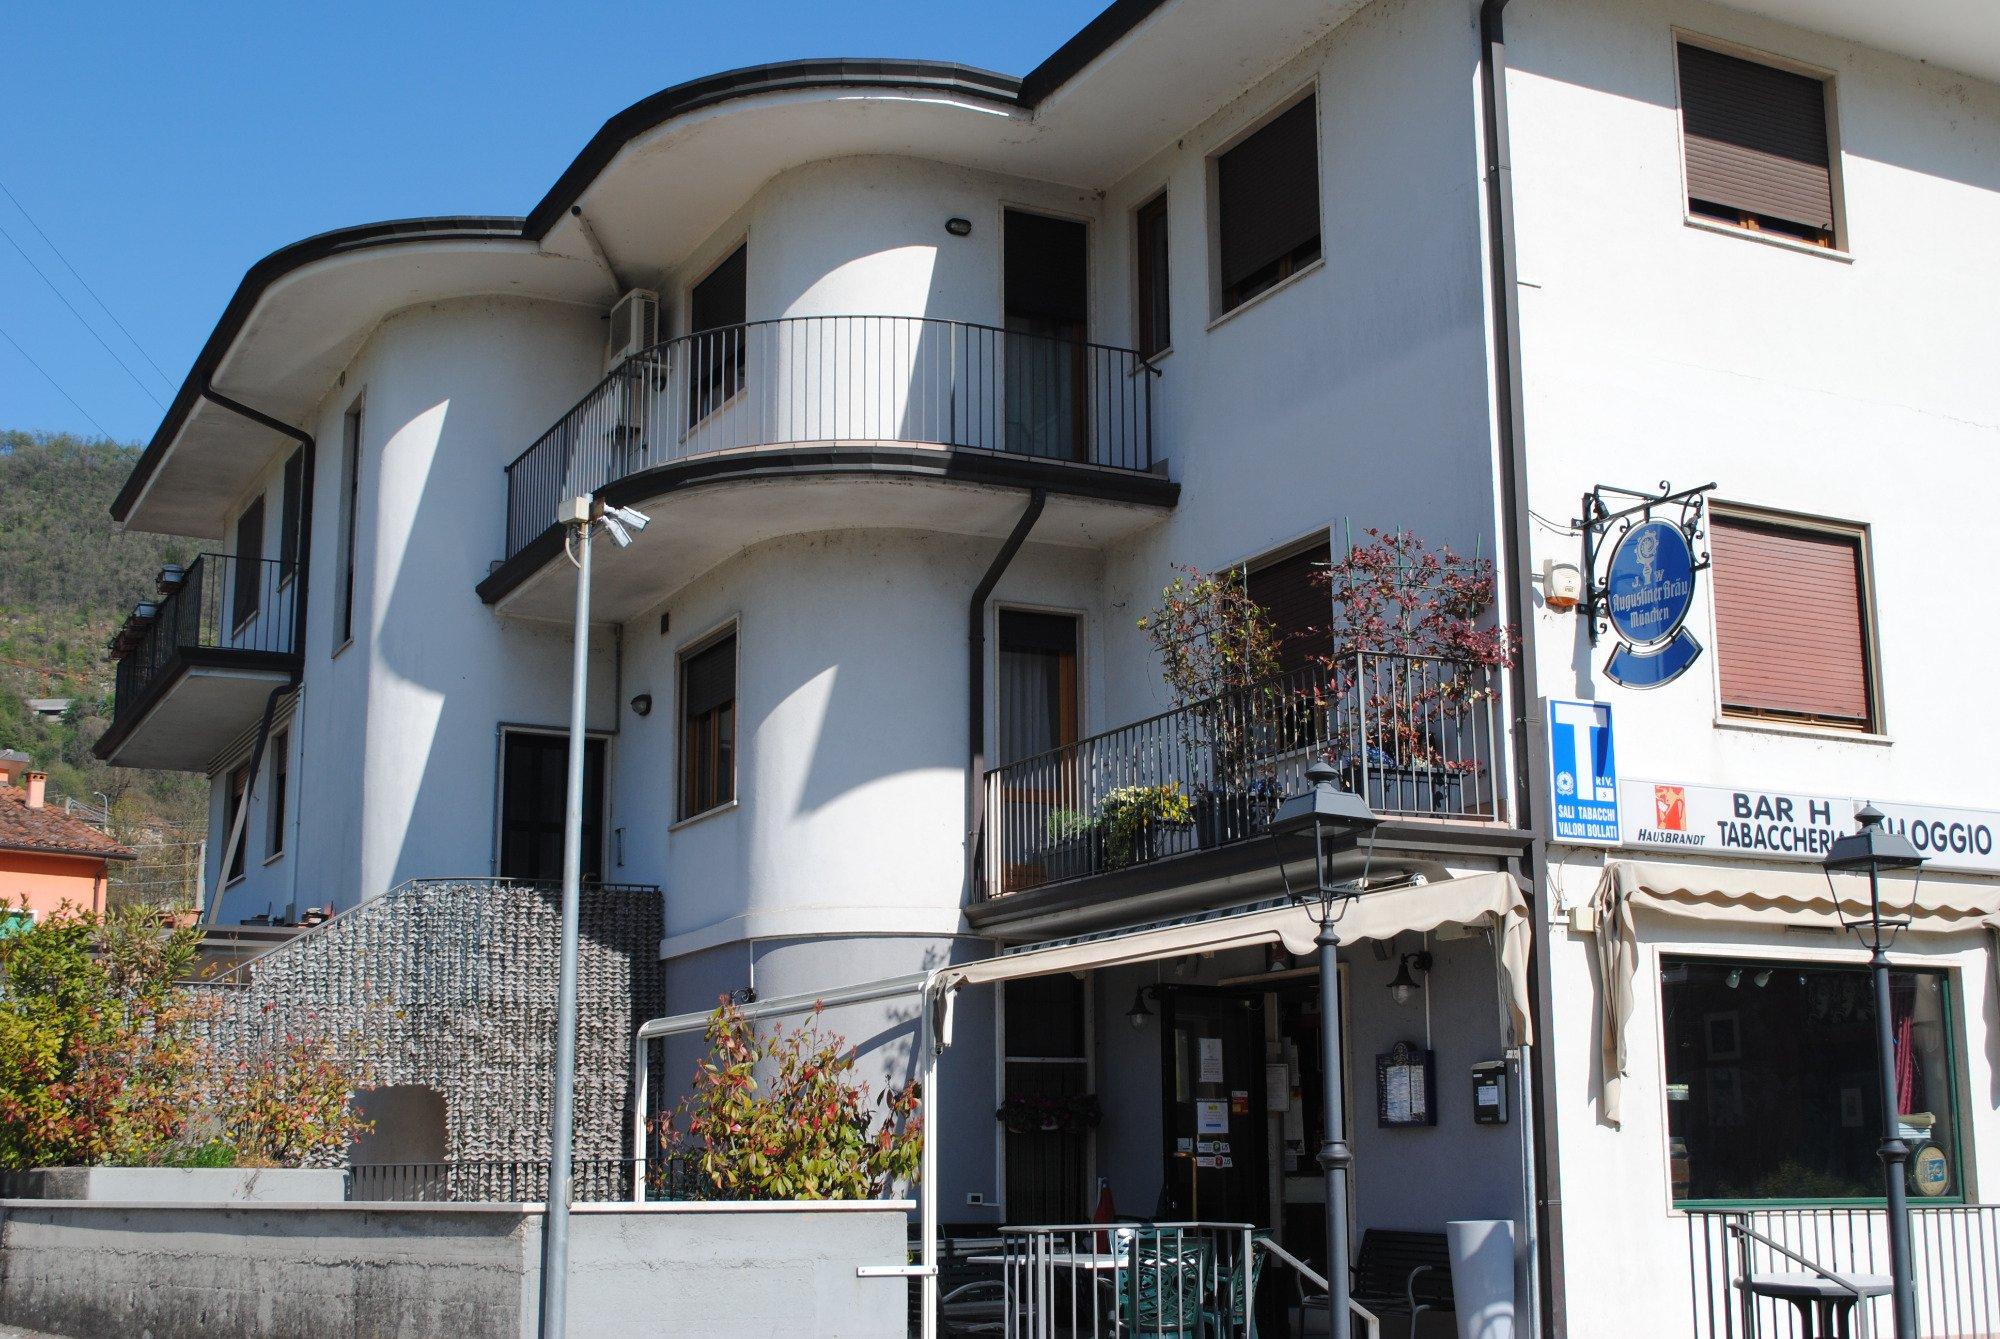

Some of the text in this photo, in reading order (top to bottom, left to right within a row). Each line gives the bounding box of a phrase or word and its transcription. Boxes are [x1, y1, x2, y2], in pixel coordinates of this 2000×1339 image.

[1554, 703, 1607, 800] T
[1595, 776, 1613, 787] RIV.
[1558, 804, 1616, 822] SALI TABACCHI
[1732, 792, 1831, 825] BAR H
[1558, 821, 1618, 839] VALORI BOLLATI
[1638, 828, 1706, 846] HAUSBRANDT
[1717, 820, 1845, 853] TABACCHERI
[1877, 816, 1992, 856] OGGIO
